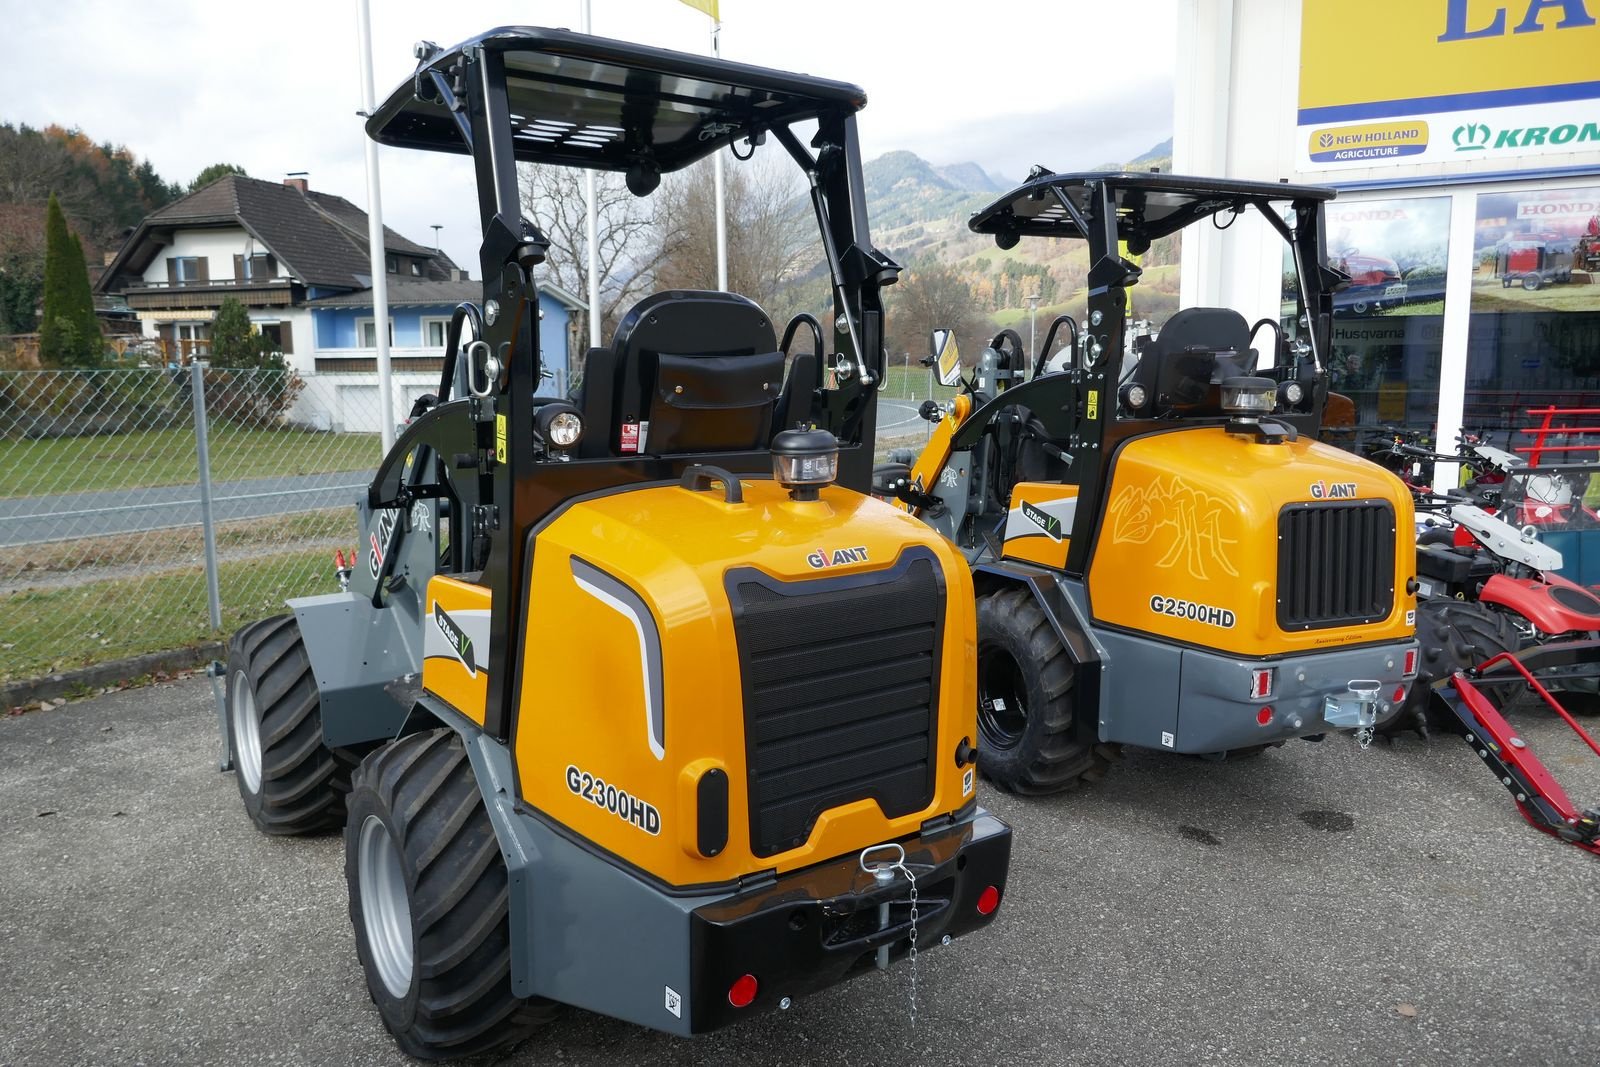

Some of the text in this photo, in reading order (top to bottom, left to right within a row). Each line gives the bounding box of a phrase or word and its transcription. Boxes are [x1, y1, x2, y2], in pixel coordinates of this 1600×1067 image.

[1336, 129, 1419, 144] NEW HOLLAND
[1334, 147, 1399, 160] AGRICULTURE
[1327, 208, 1408, 222] HONDA
[1335, 328, 1405, 341] Husqvarna
[1025, 507, 1046, 527] STAGE
[1150, 595, 1235, 629] G2500HD
[438, 614, 459, 649] STAGE
[566, 765, 661, 835] G2300HD
